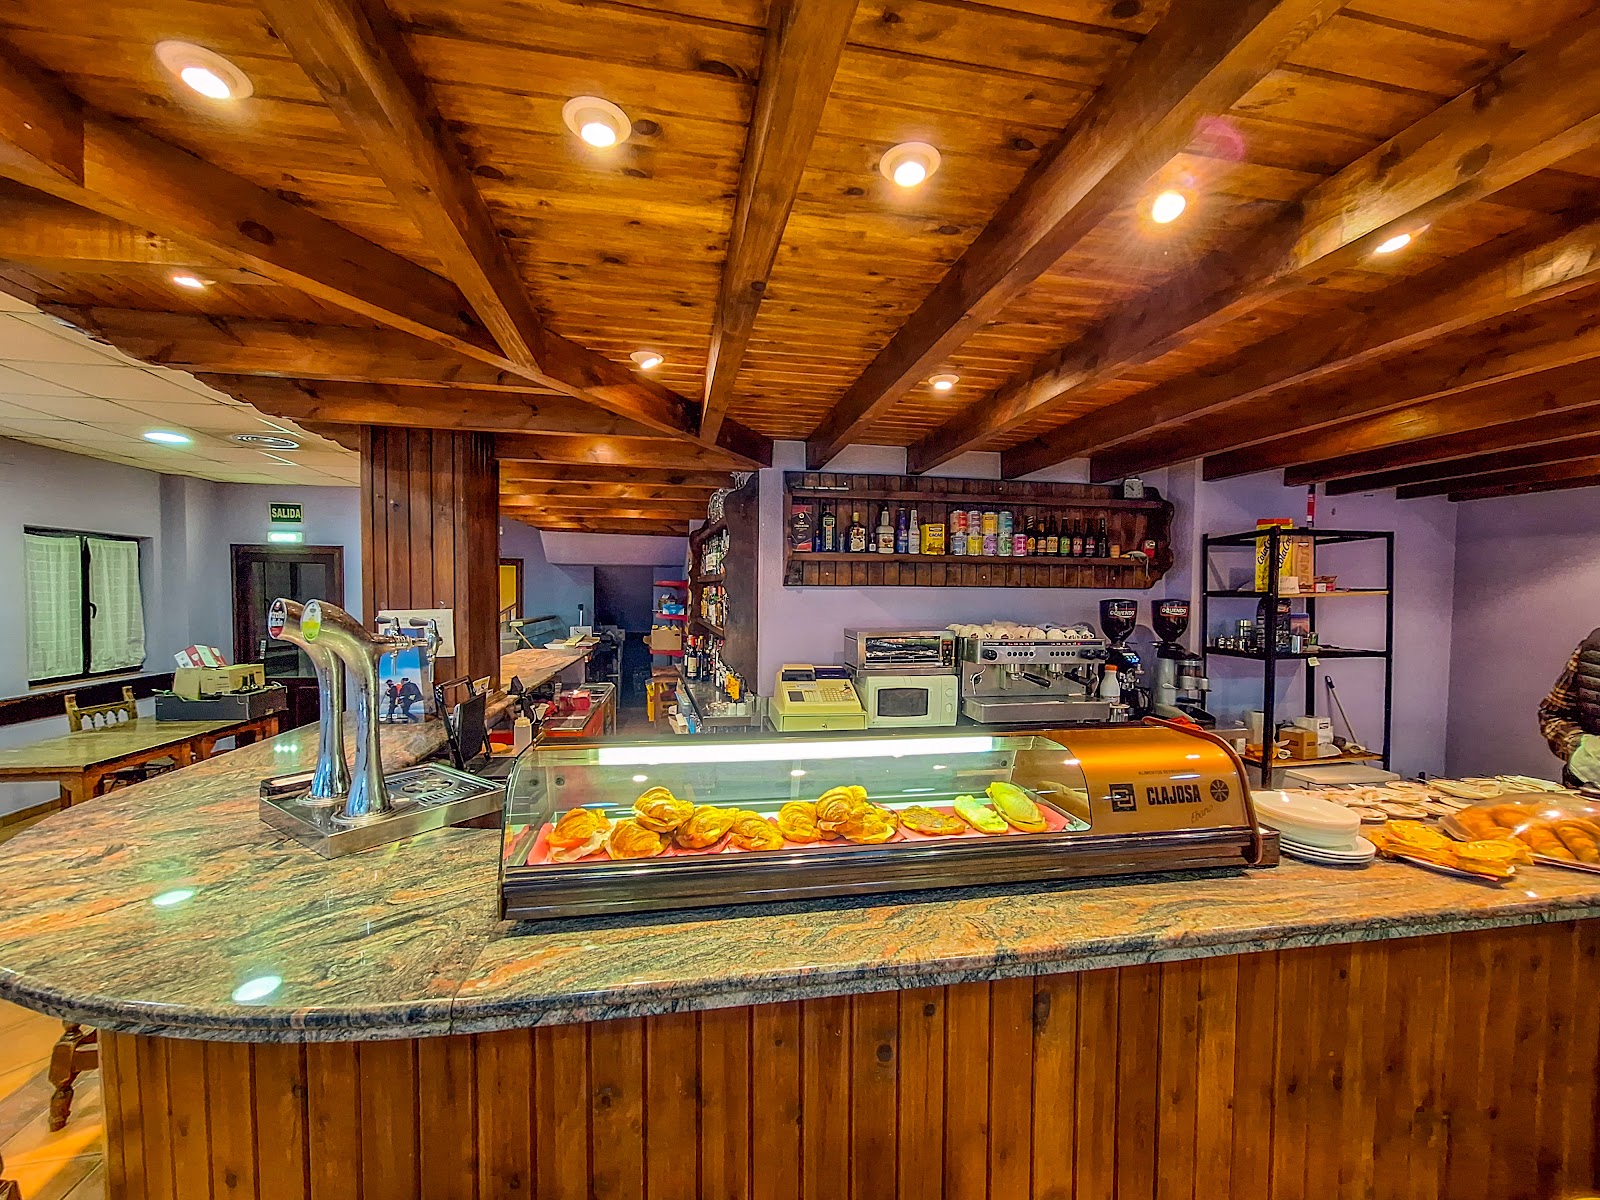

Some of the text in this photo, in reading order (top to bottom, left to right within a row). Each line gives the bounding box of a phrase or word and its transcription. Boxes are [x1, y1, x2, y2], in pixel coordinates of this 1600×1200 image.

[271, 508, 301, 519] SALIDA
[1162, 607, 1187, 615] OQUENDO
[1146, 784, 1202, 806] CLAJOSA
